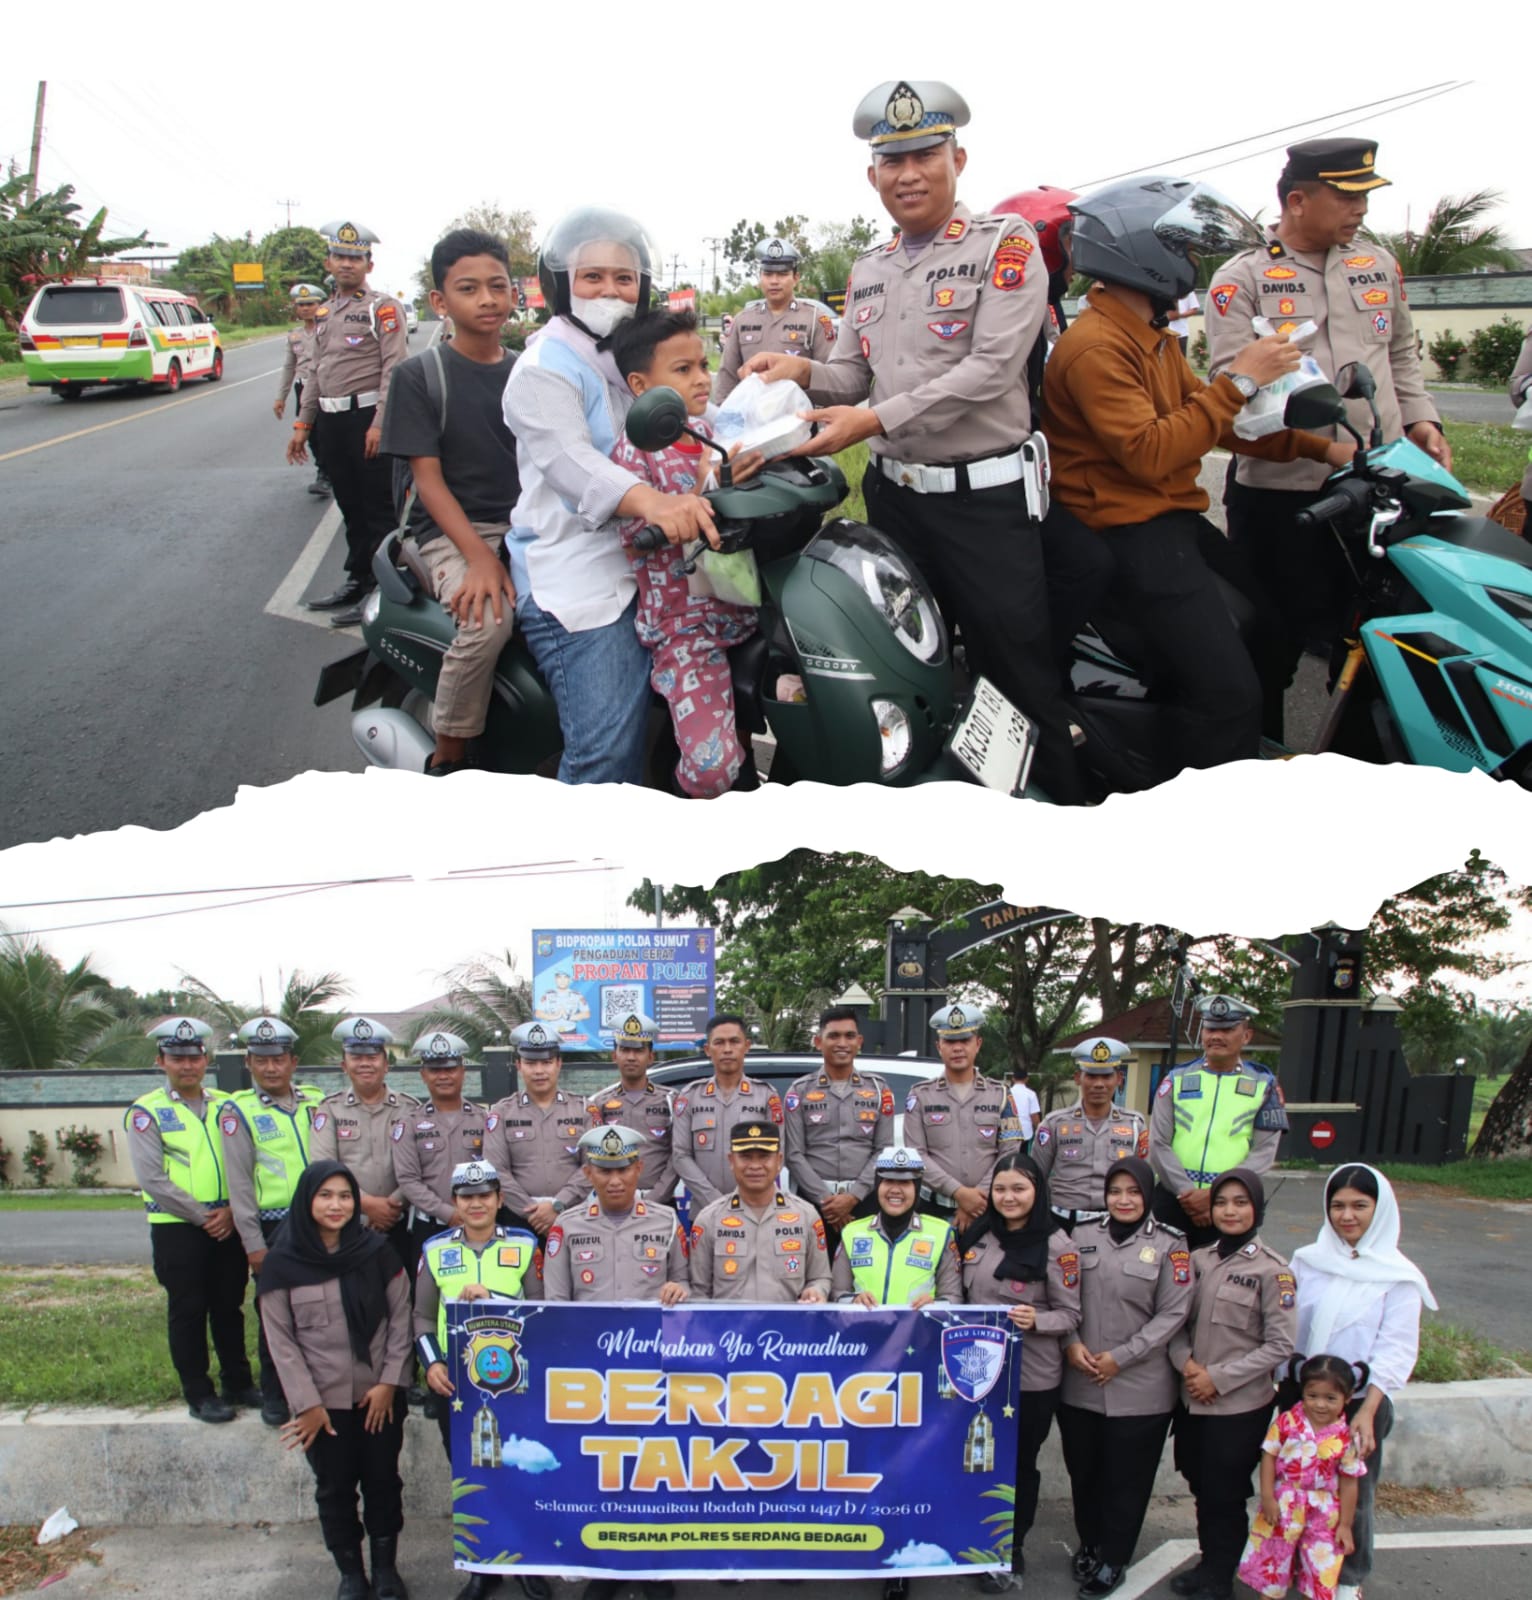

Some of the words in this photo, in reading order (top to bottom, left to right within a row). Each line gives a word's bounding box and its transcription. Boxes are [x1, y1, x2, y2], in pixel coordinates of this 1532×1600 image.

[925, 263, 977, 282] POLRI
[1348, 272, 1387, 286] POLRI
[1262, 282, 1306, 294] DAVID.S
[782, 324, 808, 332] POLRI
[380, 638, 425, 674] SCOOPY
[806, 659, 858, 672] SCOOPY
[556, 935, 616, 948] BIDPROPAM
[618, 935, 651, 947] POLDA
[654, 934, 690, 947] SUMUT
[573, 949, 639, 961] PENGADUAN
[642, 949, 675, 960] CEPAT
[573, 962, 648, 981] PROPAM
[652, 962, 707, 980] POLRI
[974, 1105, 1000, 1113] POLRI
[557, 1118, 584, 1127] POLRI
[717, 1229, 746, 1239] DAVID.S
[775, 1227, 803, 1236] POLRI
[634, 1234, 665, 1244] POLRI
[1227, 1274, 1257, 1289] POLRI
[948, 1329, 969, 1340] LALU
[972, 1329, 1001, 1340] LINTAS
[597, 1327, 715, 1359] Marhaban
[719, 1330, 754, 1362] Ya
[757, 1330, 869, 1362] Ramadhan
[545, 1367, 923, 1428] BERBAGI
[580, 1435, 884, 1493] TAKJIL
[534, 1499, 597, 1513] Selamat
[600, 1500, 699, 1514] Menunaikan
[703, 1500, 755, 1514] Ibadah
[759, 1501, 806, 1516] Puasa
[810, 1501, 842, 1515] 1447
[870, 1503, 911, 1515] 2026
[598, 1531, 668, 1543] BERSAMA
[670, 1531, 730, 1542] POLRES
[732, 1531, 801, 1543] SERDANG
[803, 1531, 867, 1543] BEDAGAI
